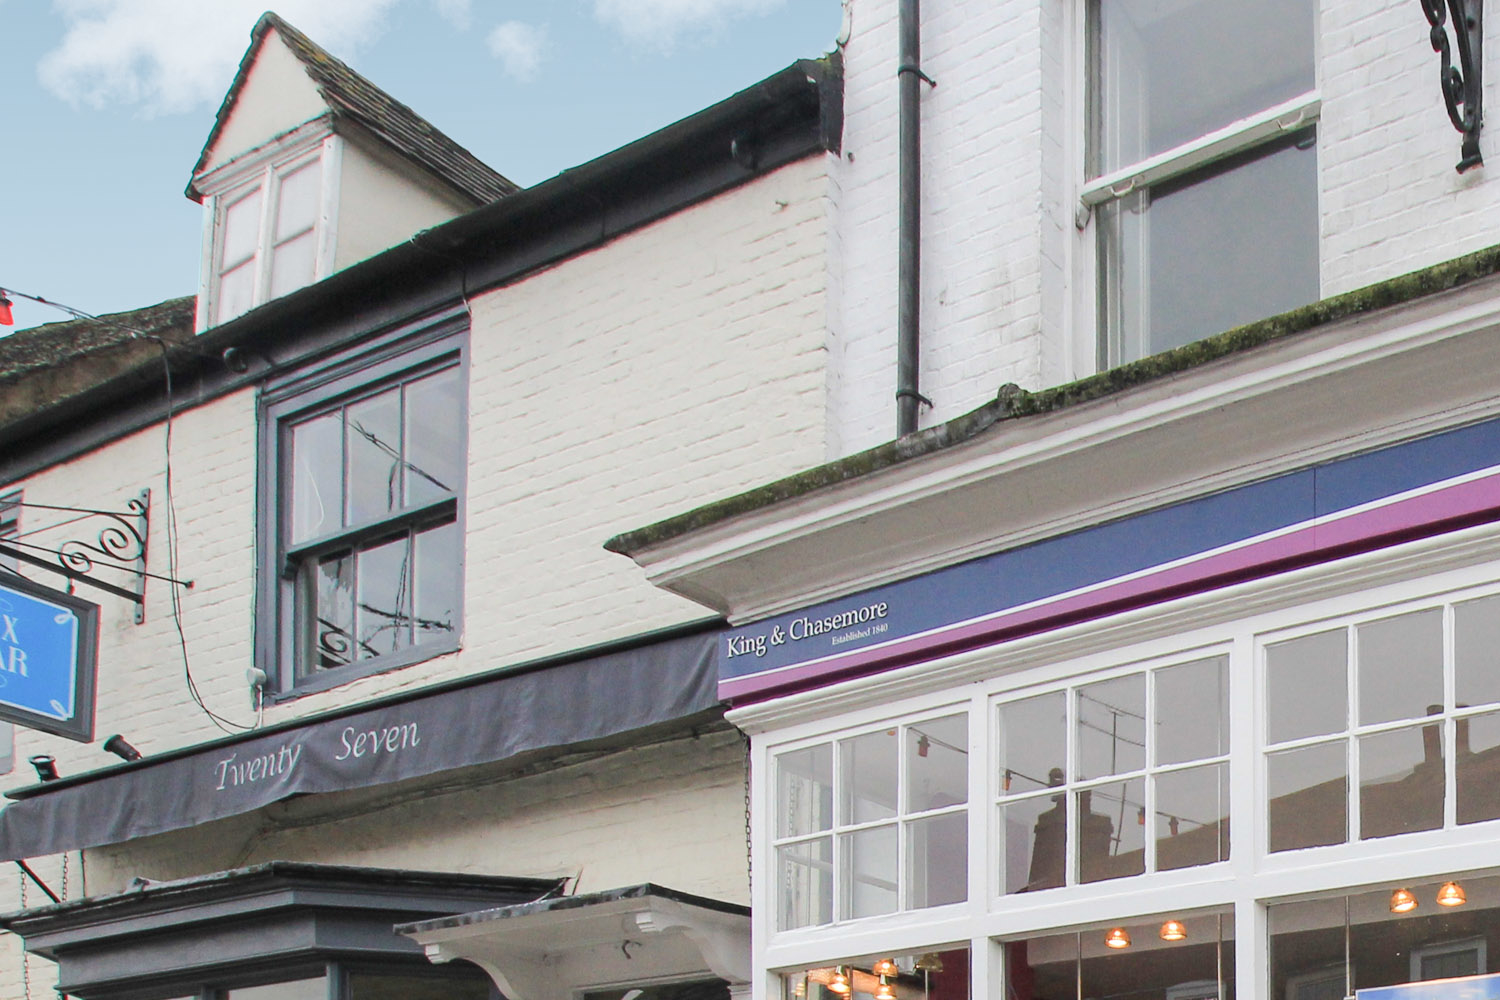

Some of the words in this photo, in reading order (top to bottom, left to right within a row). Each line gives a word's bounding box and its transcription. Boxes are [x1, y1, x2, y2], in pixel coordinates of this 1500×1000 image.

[727, 634, 767, 659] King
[770, 624, 786, 646] &
[789, 602, 888, 640] Chasemore
[831, 626, 871, 646] Established
[872, 623, 889, 635] 1840
[214, 743, 302, 791] Twenty
[335, 721, 421, 761] Seven
